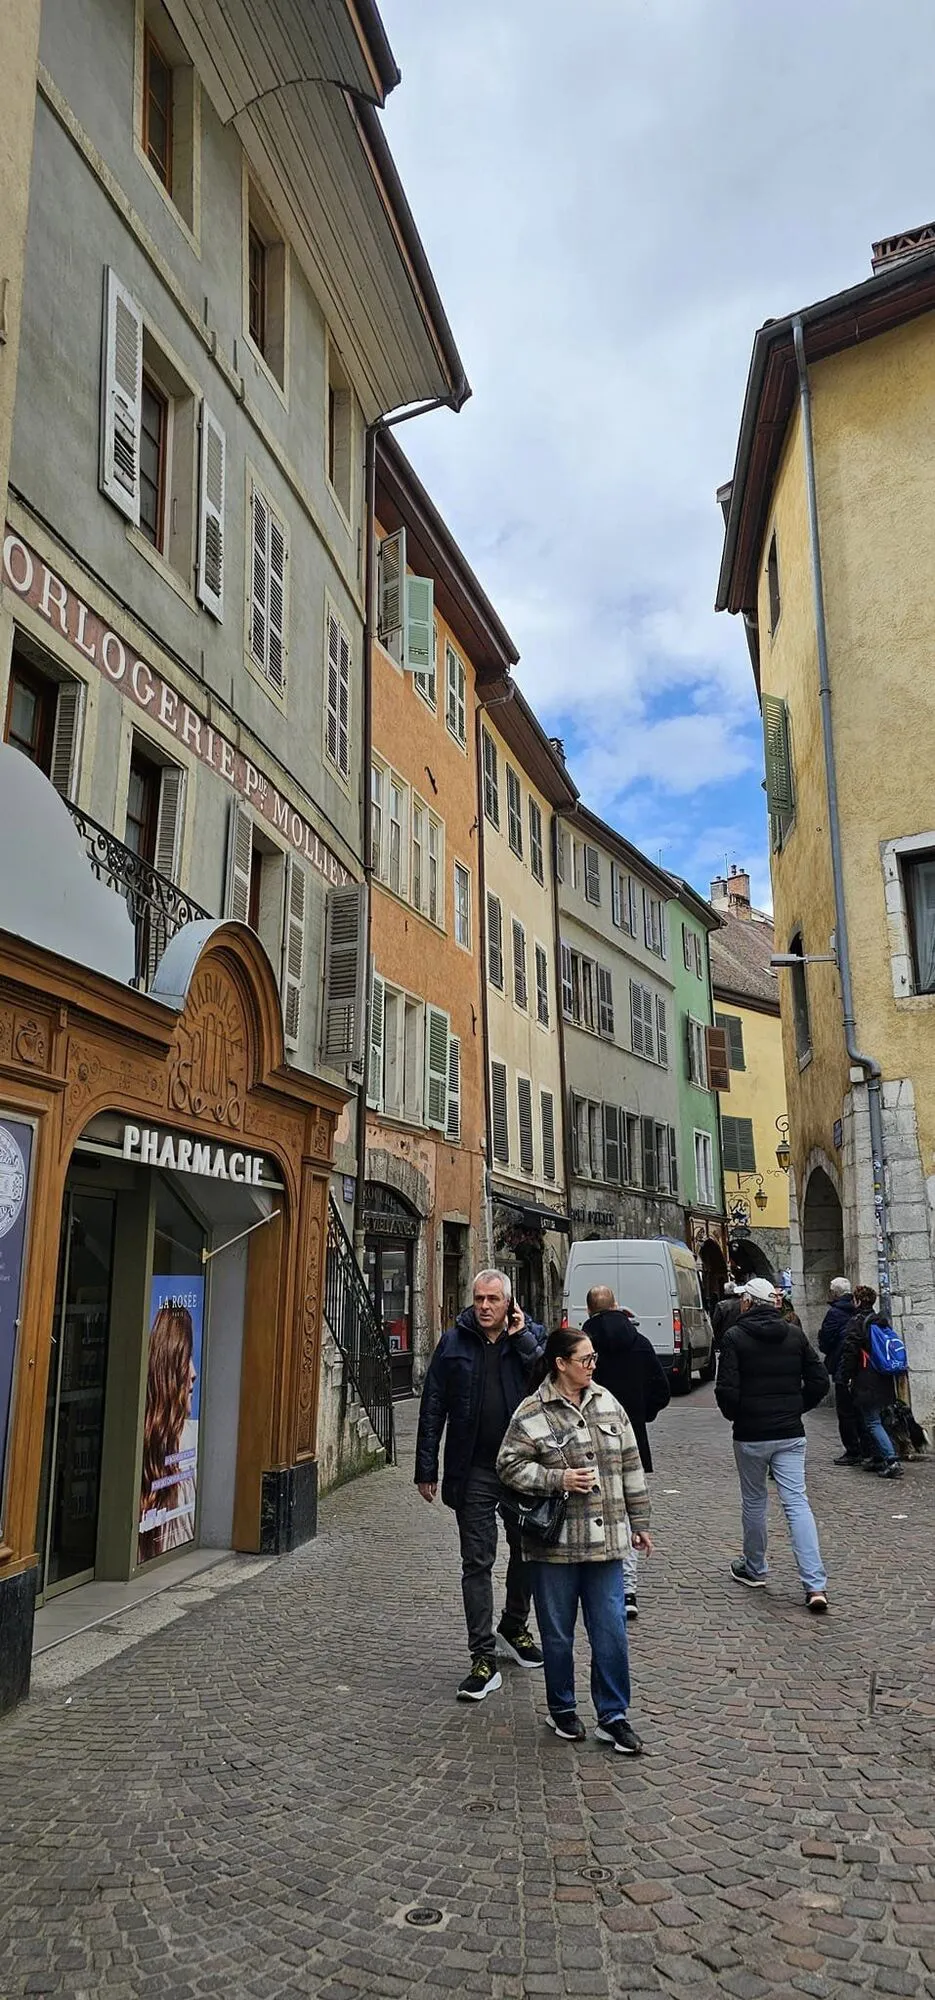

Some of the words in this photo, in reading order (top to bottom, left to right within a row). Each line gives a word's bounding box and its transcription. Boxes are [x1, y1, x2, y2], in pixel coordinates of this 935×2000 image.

[271, 790, 348, 886] MOLLIEY
[122, 1124, 265, 1187] PHARMACIE
[158, 1295, 169, 1309] LA
[172, 1291, 197, 1309] ROSÉE
